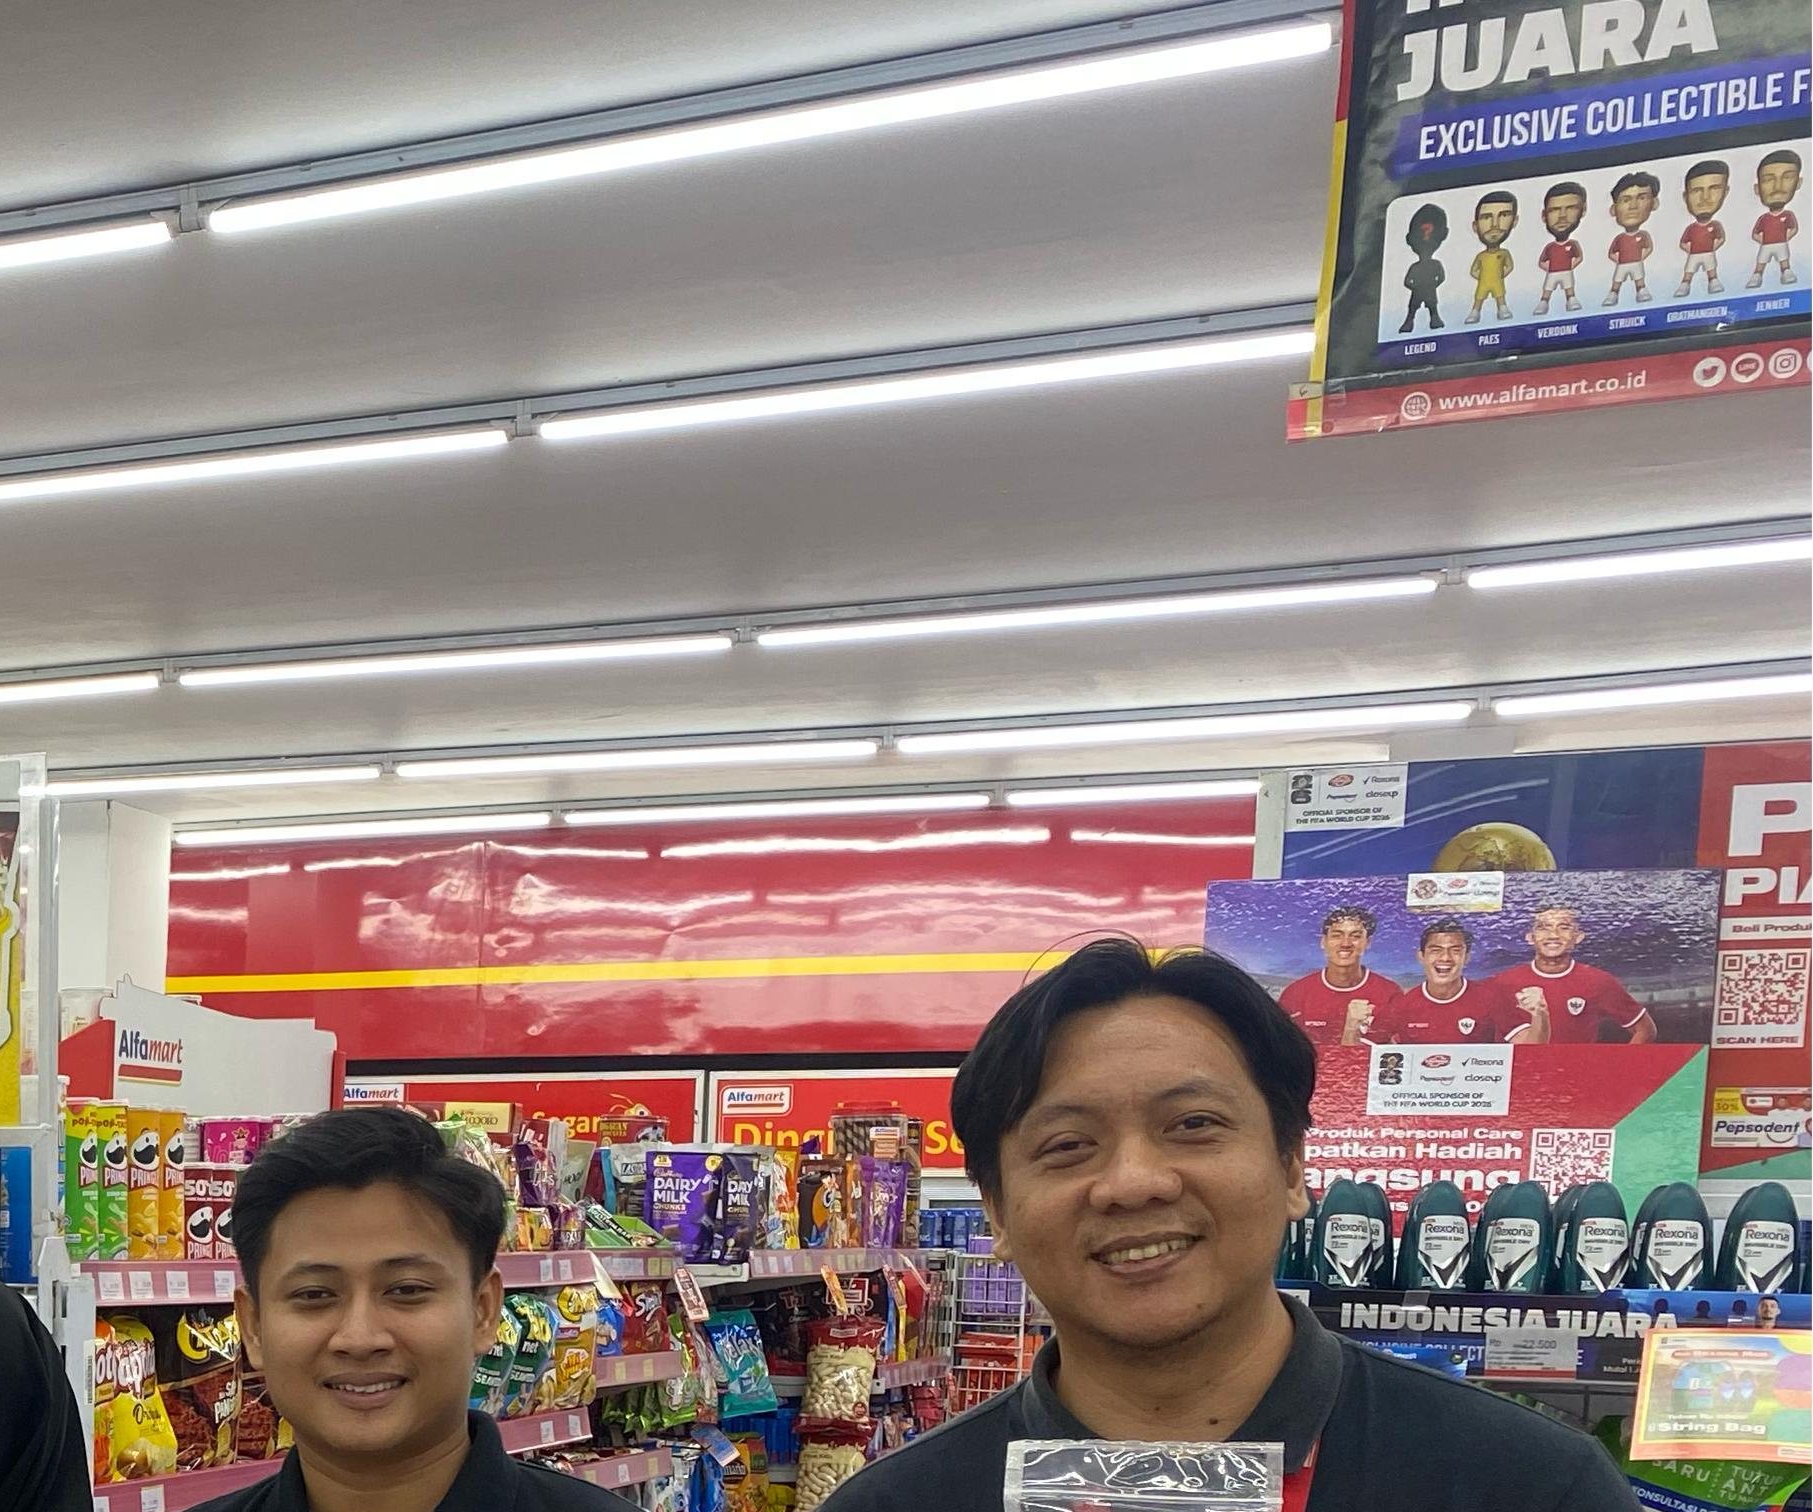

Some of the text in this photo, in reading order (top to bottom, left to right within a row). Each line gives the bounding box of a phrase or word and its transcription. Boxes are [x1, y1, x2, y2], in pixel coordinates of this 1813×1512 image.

[1398, 0, 1719, 101] JUARA
[1419, 75, 1782, 160] EXCLUSIVE COLLECTIBLE
[1478, 334, 1500, 347] PAES
[1404, 341, 1437, 355] LEGEND
[1439, 371, 1647, 412] www.alfamart.co.id
[118, 1028, 184, 1065] Alfamart
[1716, 1035, 1800, 1046] SCAN HERE
[343, 1086, 400, 1100] Alfamart
[728, 1089, 785, 1103] Alfamart
[1307, 1127, 1524, 1140] Produk Personal Care
[1714, 1119, 1799, 1136] Pepsodent
[1415, 1142, 1523, 1160] Hadiah
[654, 1177, 701, 1193] DAIRY
[654, 1190, 691, 1204] MILK
[1424, 1222, 1466, 1235] Rexona
[1585, 1225, 1627, 1238] Rexona
[1655, 1227, 1699, 1241] Rexona
[1745, 1229, 1790, 1242] Rexona
[1340, 1302, 1678, 1338] INDONESIA JUARA
[1658, 1421, 1767, 1434] String Bag
